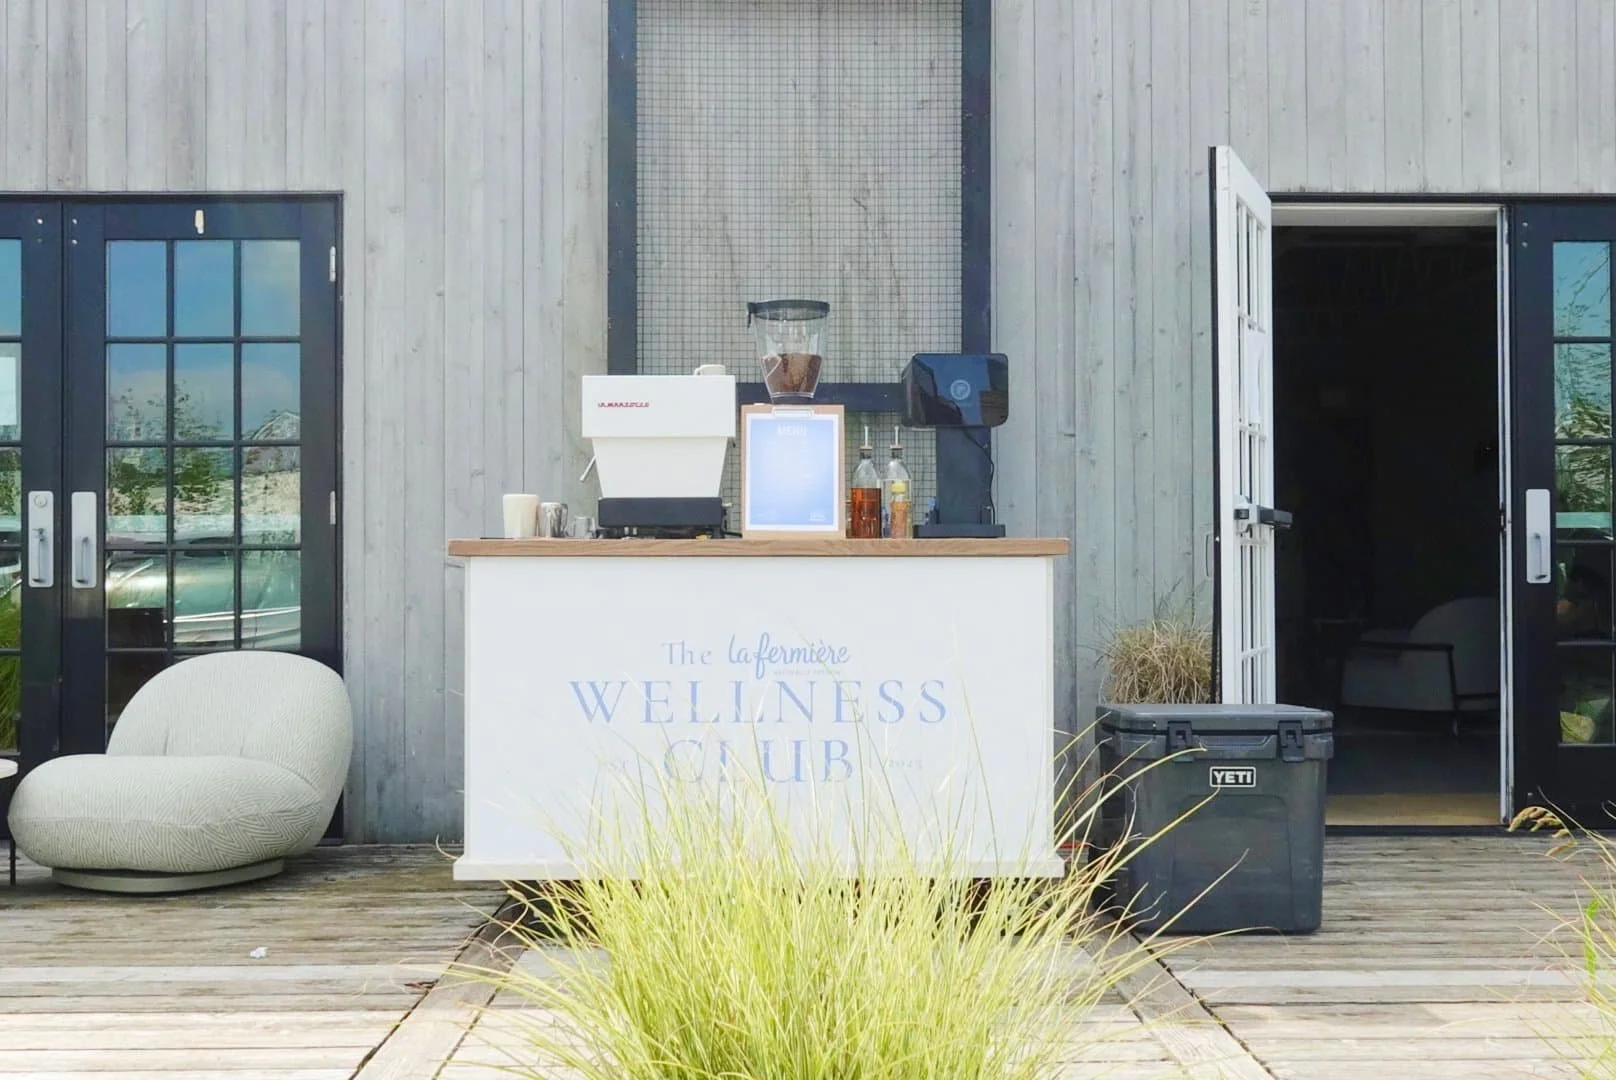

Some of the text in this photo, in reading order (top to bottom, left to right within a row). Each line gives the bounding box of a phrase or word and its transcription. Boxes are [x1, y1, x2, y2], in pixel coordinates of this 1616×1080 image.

[661, 640, 713, 665] The
[569, 679, 947, 724] WELLNESS
[664, 739, 853, 783] CLUB
[1213, 771, 1253, 784] YETI
